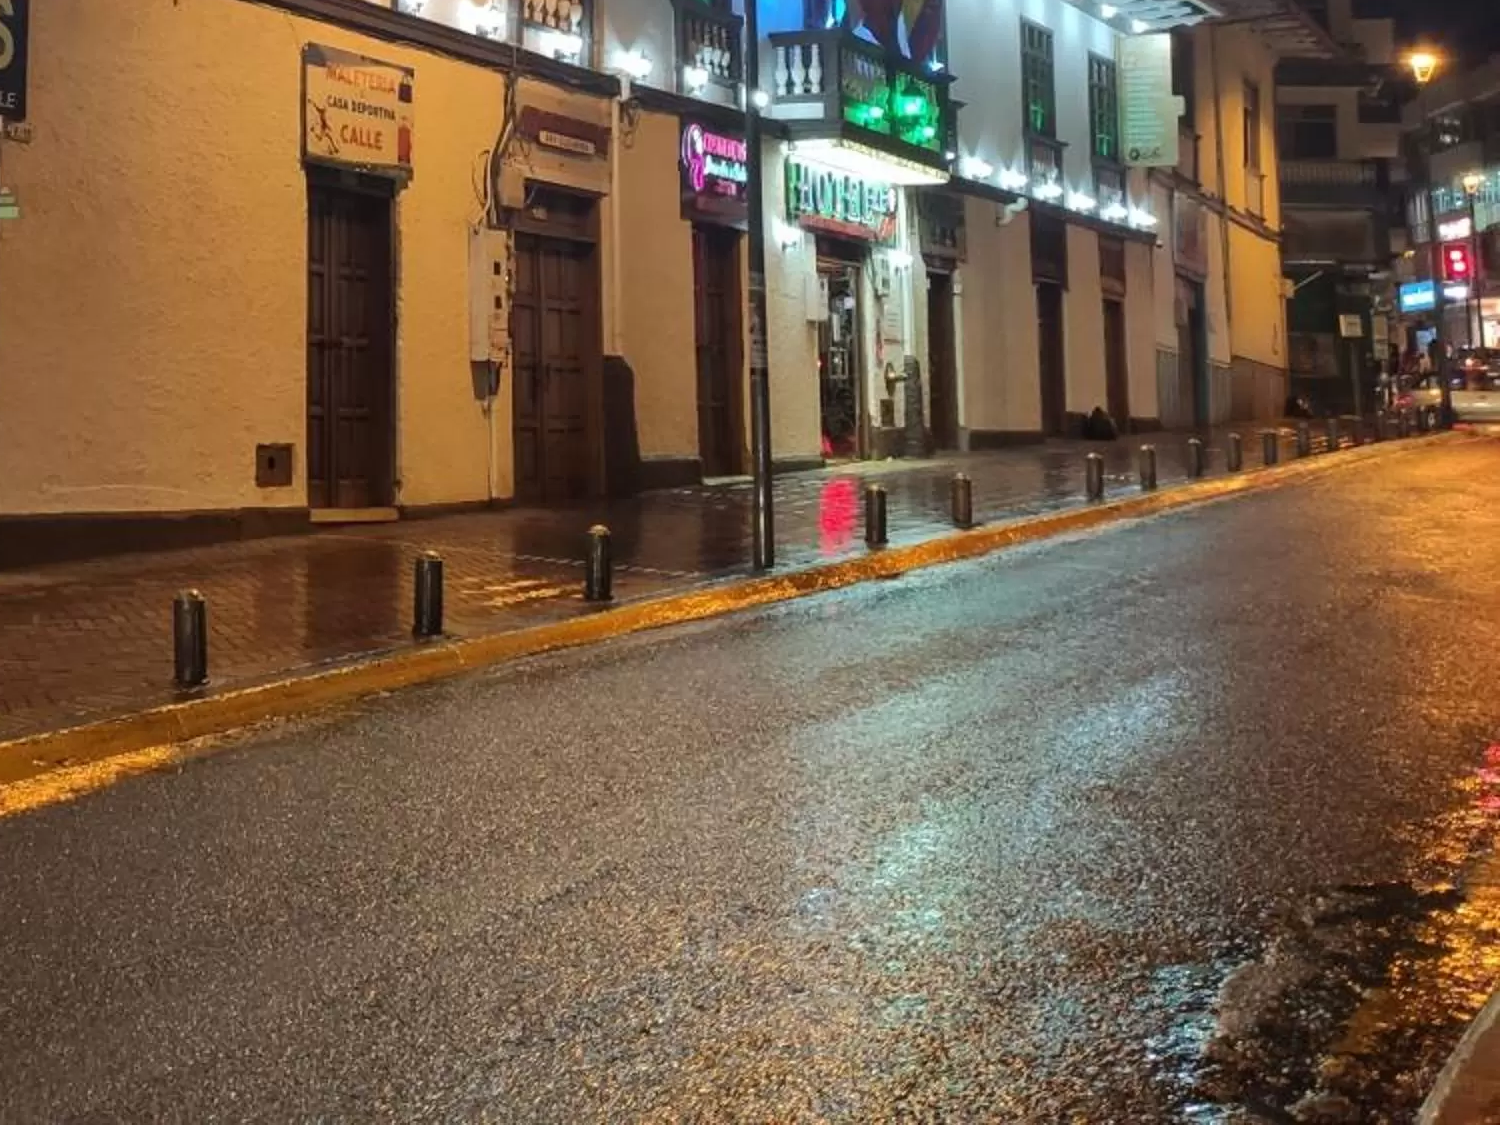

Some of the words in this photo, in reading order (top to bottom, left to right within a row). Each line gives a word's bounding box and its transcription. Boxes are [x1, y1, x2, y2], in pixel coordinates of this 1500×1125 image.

[327, 94, 349, 110] CASA
[351, 100, 397, 121] DEPORTIVA
[340, 124, 383, 151] CALLE
